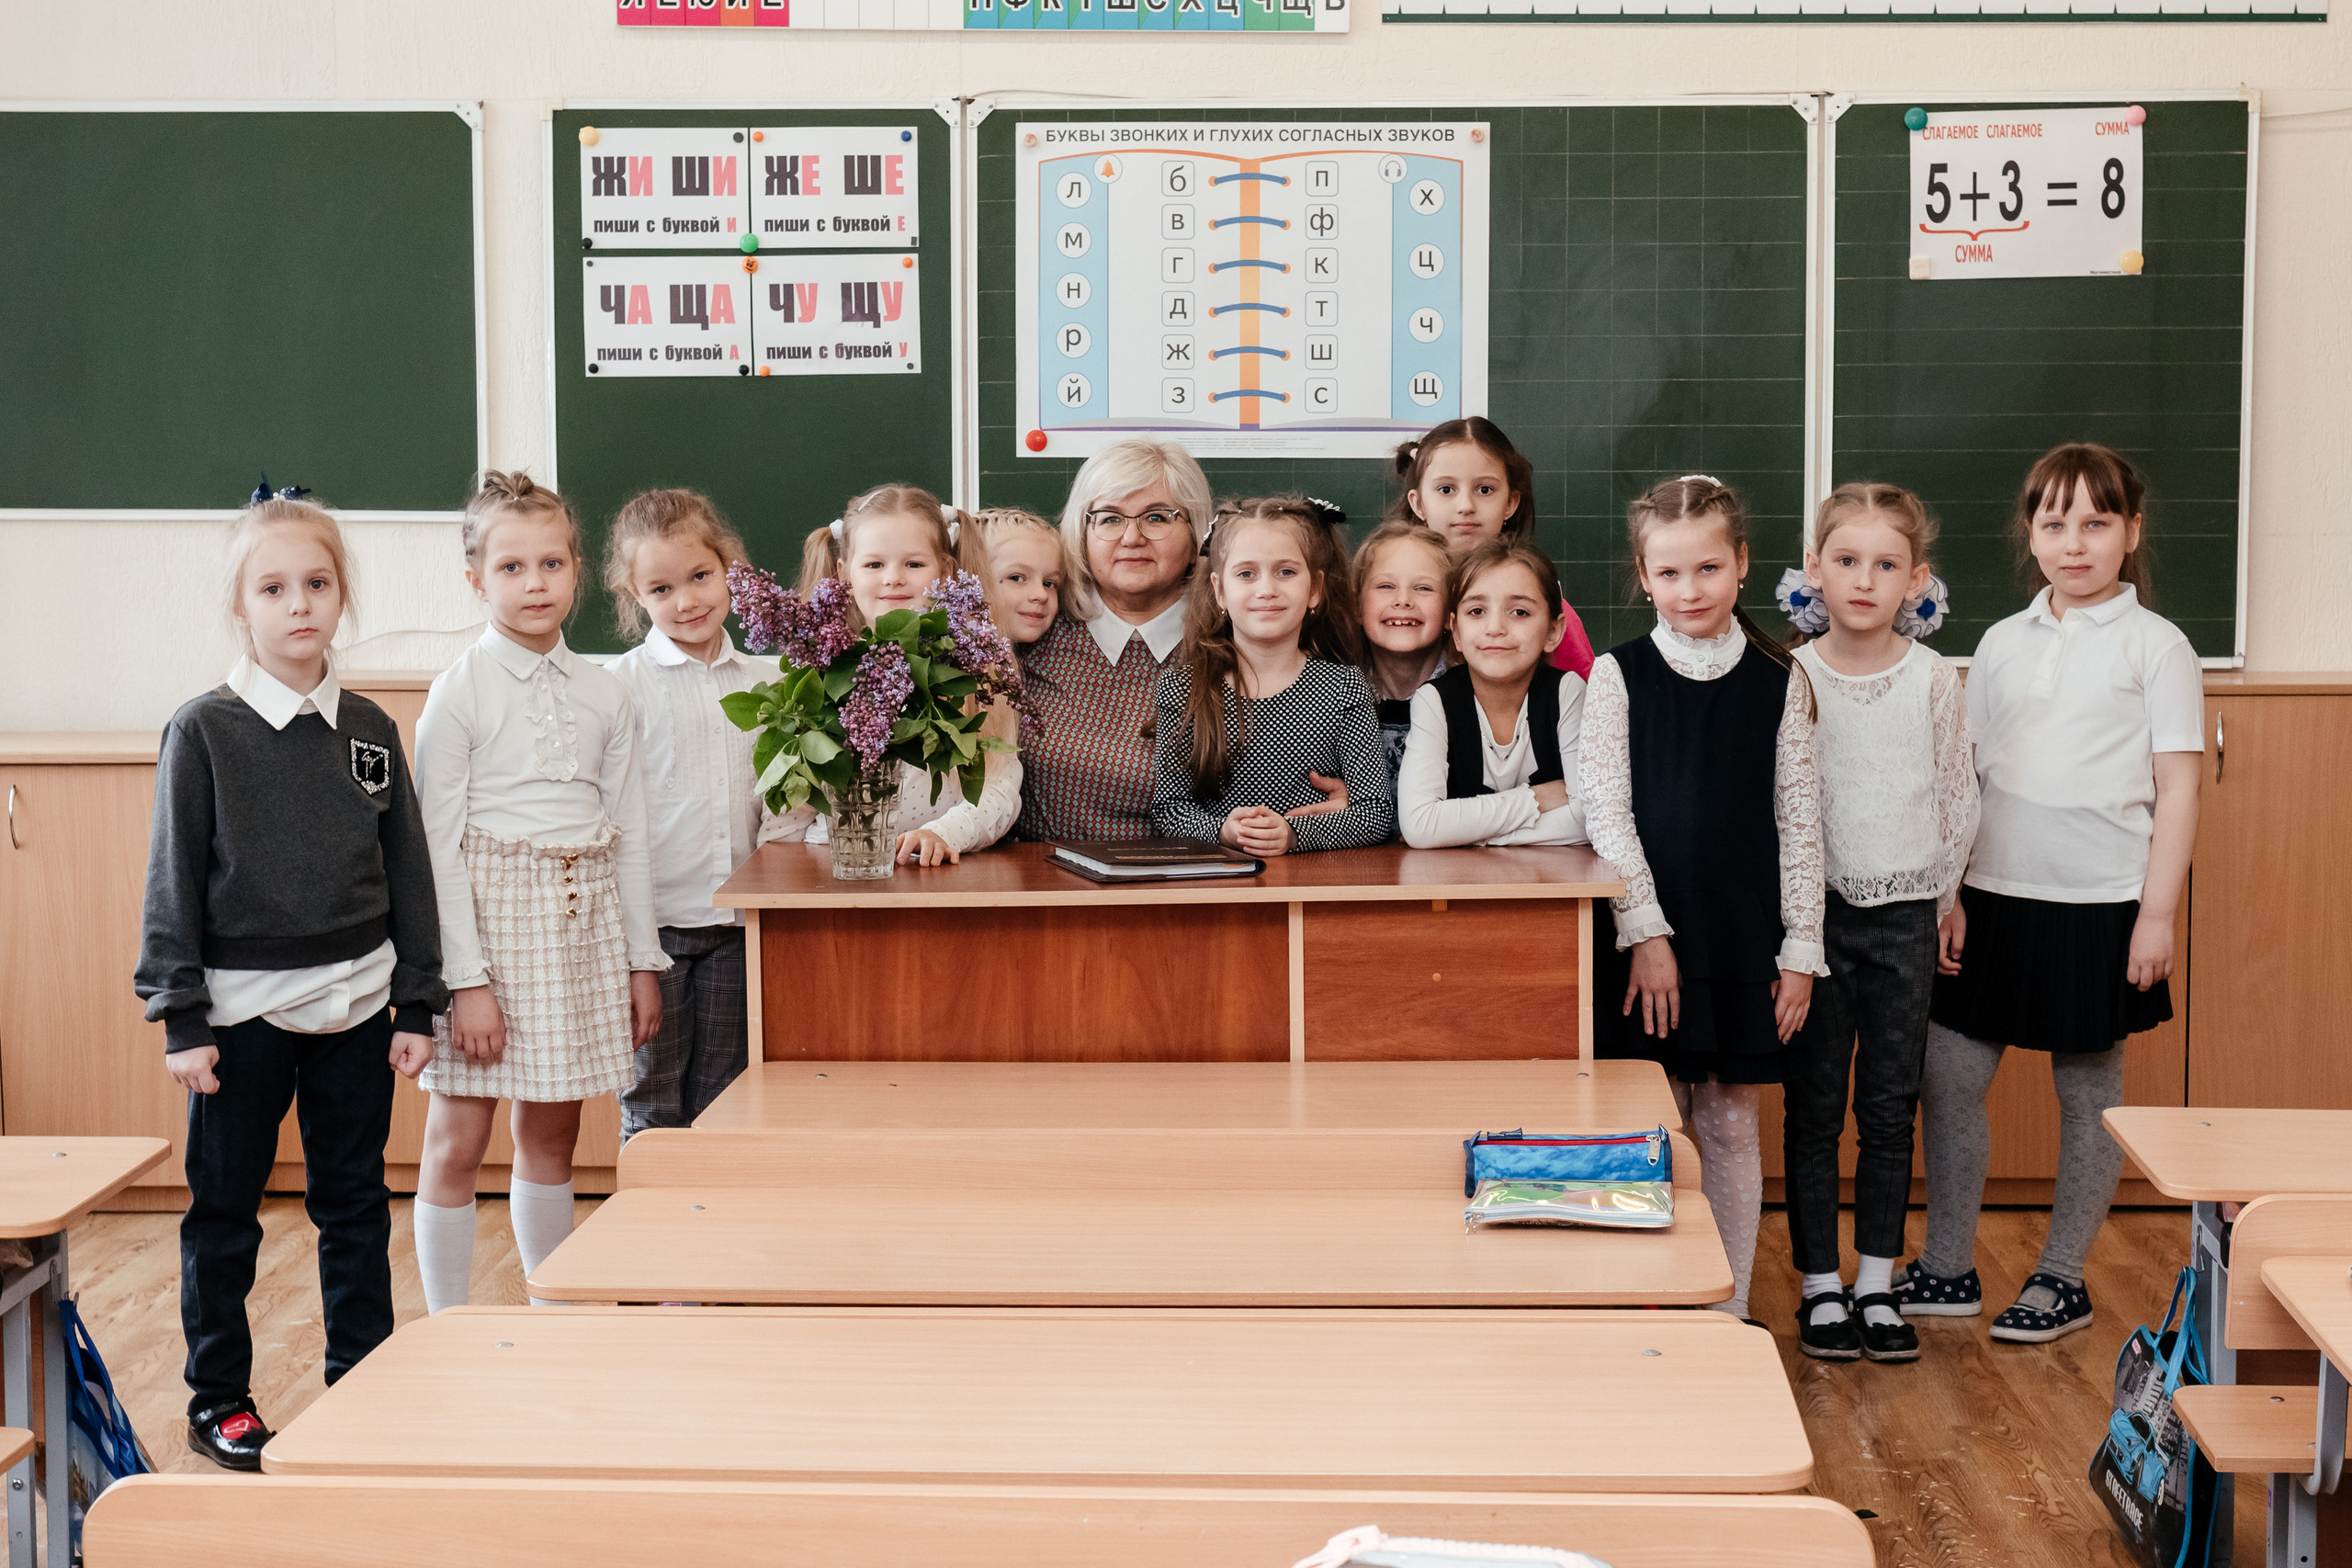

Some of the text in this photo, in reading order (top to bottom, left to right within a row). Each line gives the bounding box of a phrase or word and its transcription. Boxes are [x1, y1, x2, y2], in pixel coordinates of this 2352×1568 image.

[1046, 129, 1455, 142] БУКВЫ ЗВОНКИХ И ГЛУХИХ СОГЛАСНЫХ ЗВУКОВ
[1922, 123, 2042, 141] СЛАГАЕМОЕ СЛАГАЕМОЕ
[2095, 121, 2130, 136] СУММА
[591, 155, 737, 197] ЖИ ШИ
[764, 154, 904, 197] ЖЕ ШЕ
[1170, 164, 1187, 192] б
[2047, 182, 2078, 207] =
[2100, 157, 2126, 220] 8
[594, 216, 737, 234] пиши с буквой И
[764, 214, 906, 233] пиши с буквой Е
[1309, 207, 1334, 237] ф
[1955, 243, 1994, 264] СУММА
[600, 284, 735, 332] ЧА ЩА
[768, 281, 903, 329] ЧУ ЩУ
[766, 341, 908, 360] пиши с буквой У
[1066, 329, 1082, 353] р
[596, 344, 740, 362] пиши с буквой А
